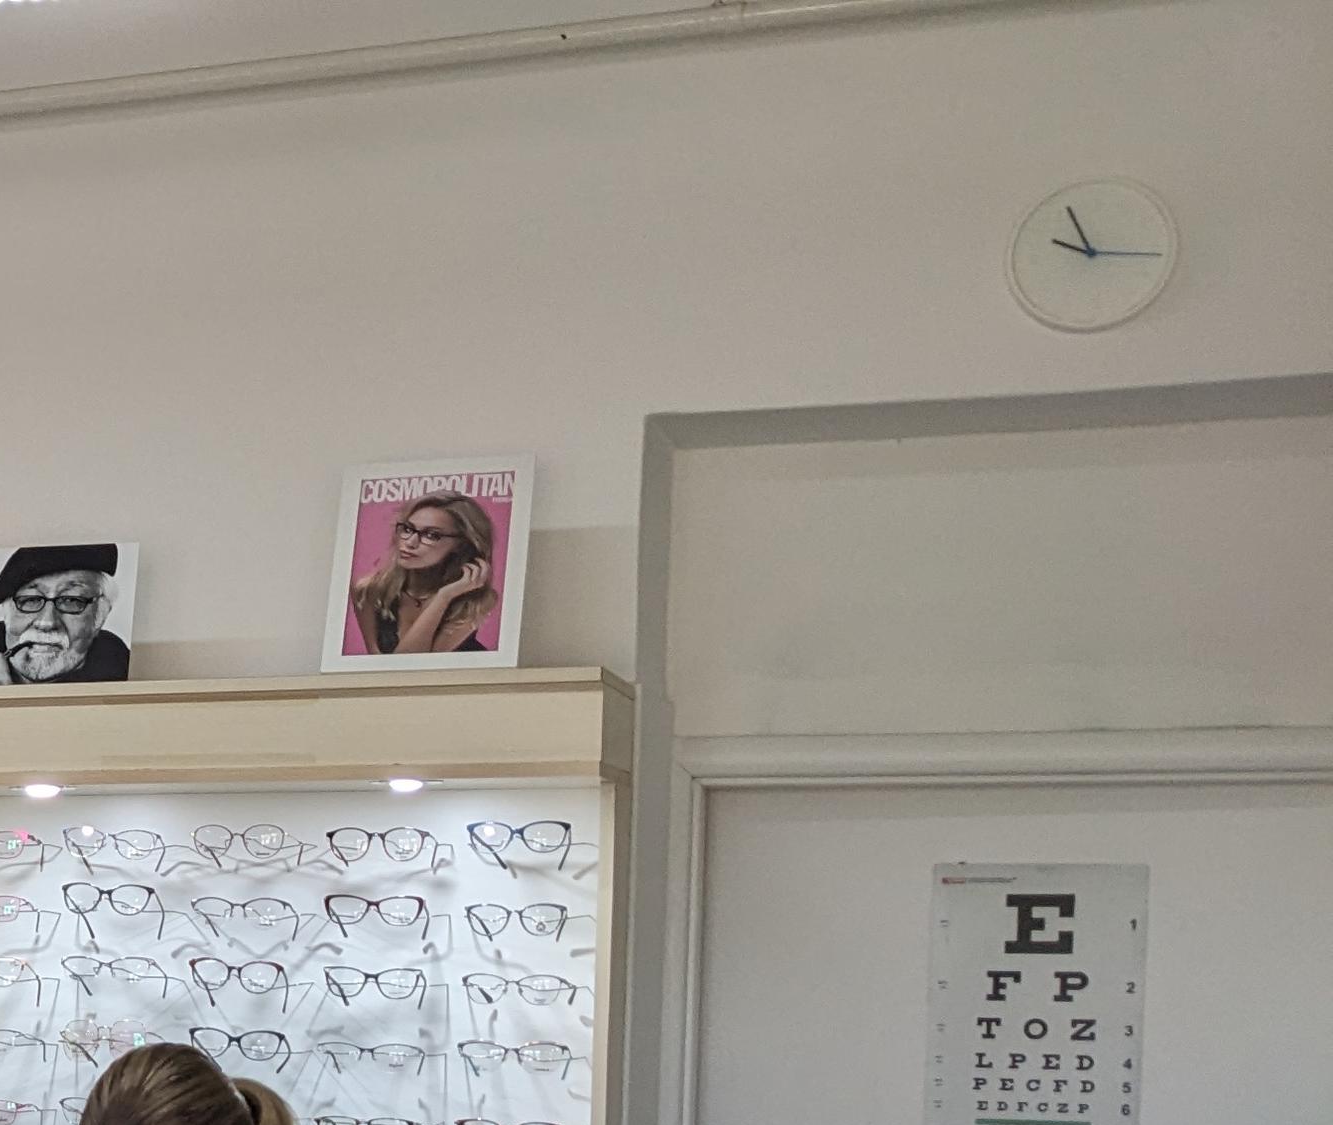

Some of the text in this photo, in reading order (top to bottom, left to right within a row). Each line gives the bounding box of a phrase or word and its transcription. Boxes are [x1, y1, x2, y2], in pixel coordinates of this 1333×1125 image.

[361, 472, 515, 503] COSMOPOLITAN
[1004, 893, 1137, 954] E 1
[1126, 981, 1135, 994] 2
[1124, 1025, 1133, 1037] 3
[1122, 1058, 1132, 1069] 4
[1122, 1082, 1131, 1093] 5
[1120, 1104, 1130, 1116] 6
